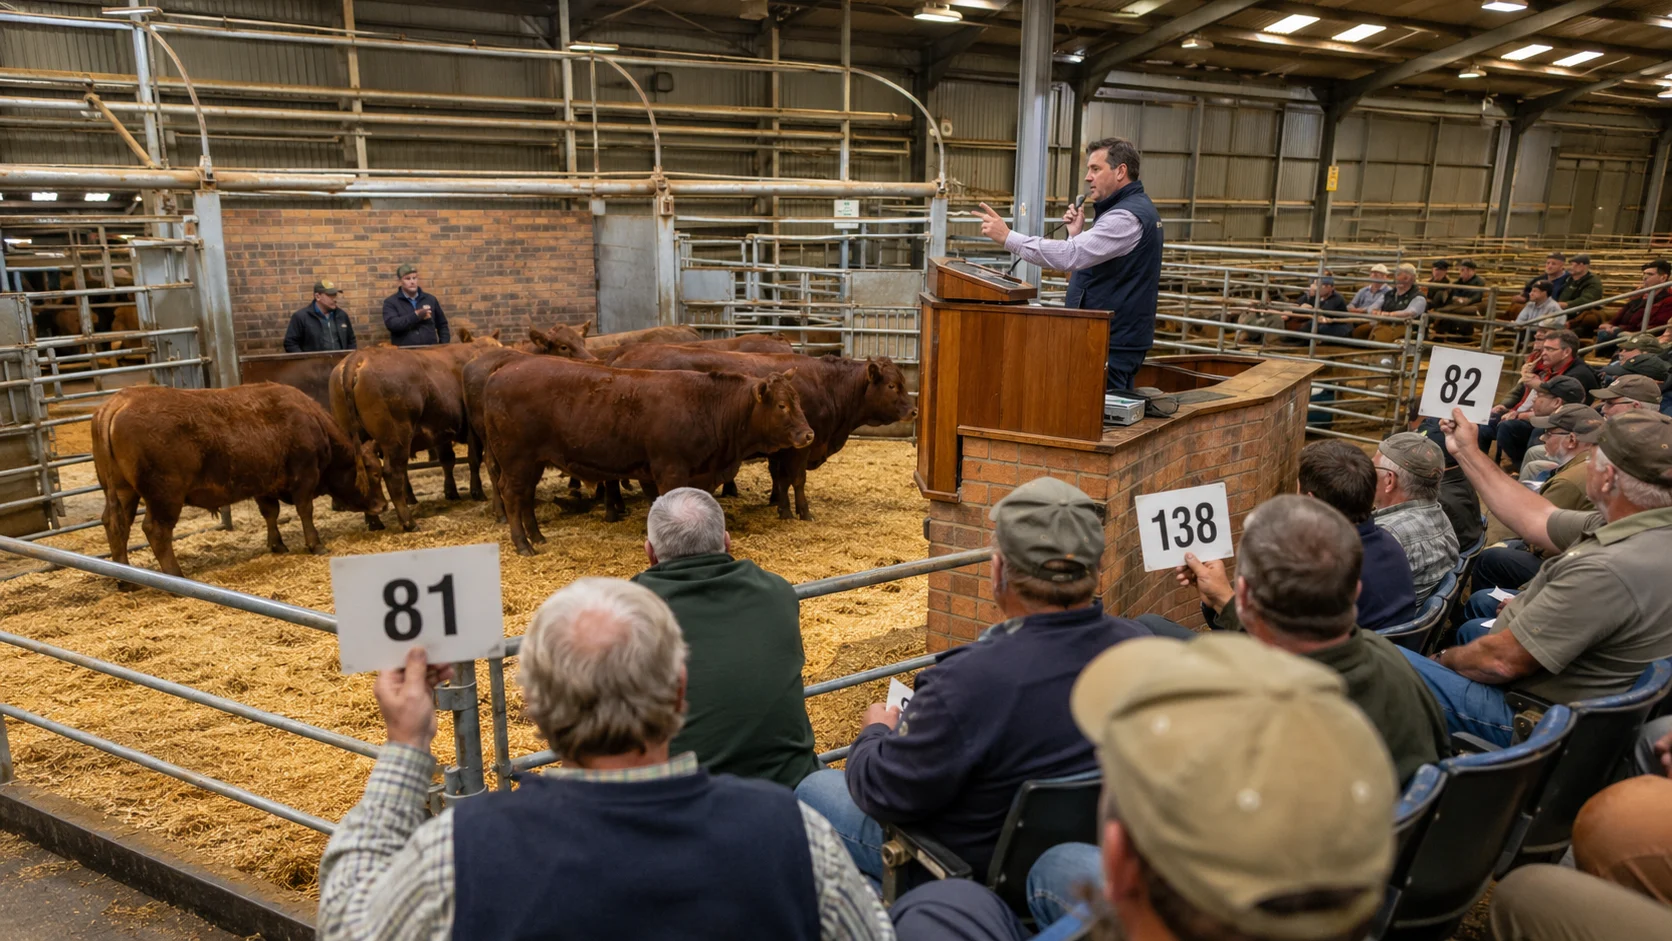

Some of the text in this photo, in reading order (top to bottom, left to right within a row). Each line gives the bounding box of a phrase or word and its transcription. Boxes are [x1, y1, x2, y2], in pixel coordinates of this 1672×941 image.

[1440, 364, 1482, 407] 82
[1151, 502, 1217, 551] 138
[382, 573, 458, 641] 81
